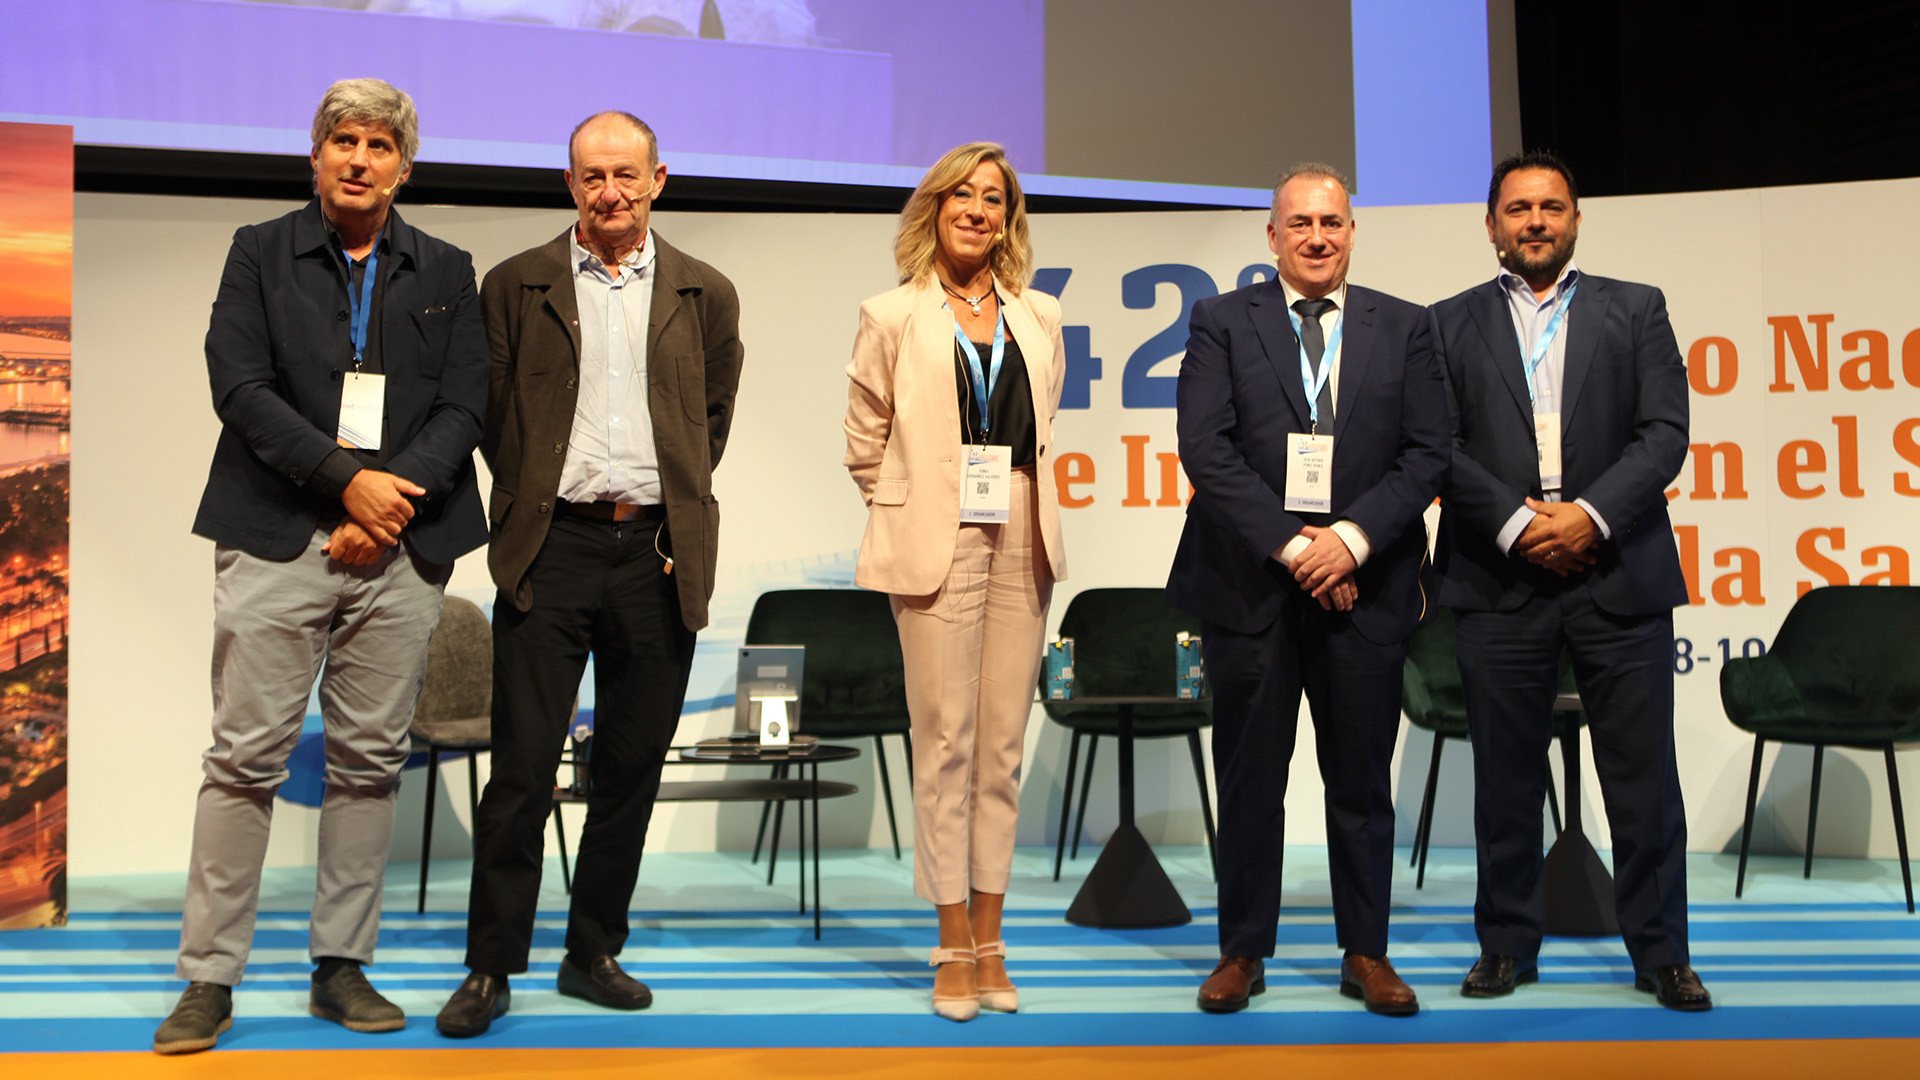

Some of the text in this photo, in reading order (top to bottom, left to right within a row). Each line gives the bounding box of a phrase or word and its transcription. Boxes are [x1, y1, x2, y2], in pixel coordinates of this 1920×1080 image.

[1687, 336, 1739, 396] o
[1053, 452, 1096, 509] e
[1120, 435, 1195, 507] In
[1777, 415, 1865, 500] el
[1892, 417, 1920, 498] S
[1673, 525, 1910, 607] la Sa
